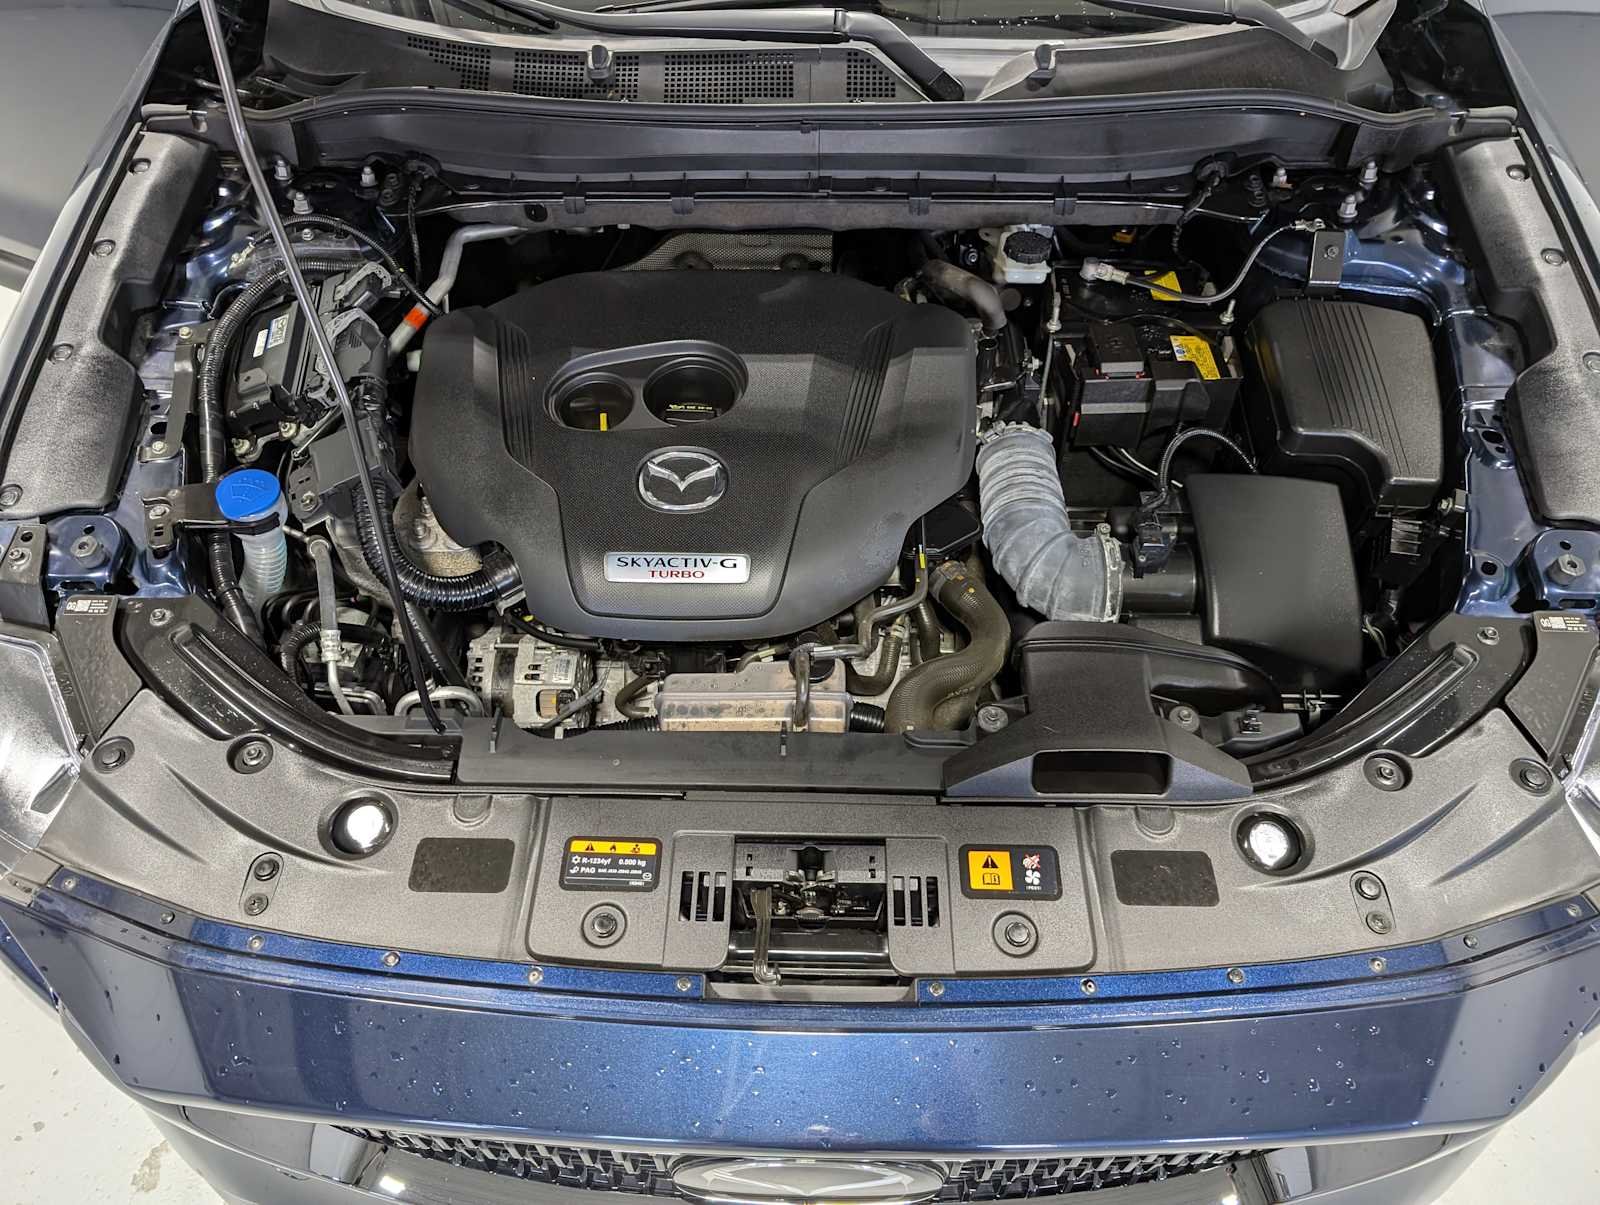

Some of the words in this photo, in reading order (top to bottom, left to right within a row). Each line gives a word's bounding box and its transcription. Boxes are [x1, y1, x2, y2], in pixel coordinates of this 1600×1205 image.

[616, 556, 737, 569] SKYACTIV-G
[649, 570, 705, 579] TURBO
[637, 859, 646, 867] kg
